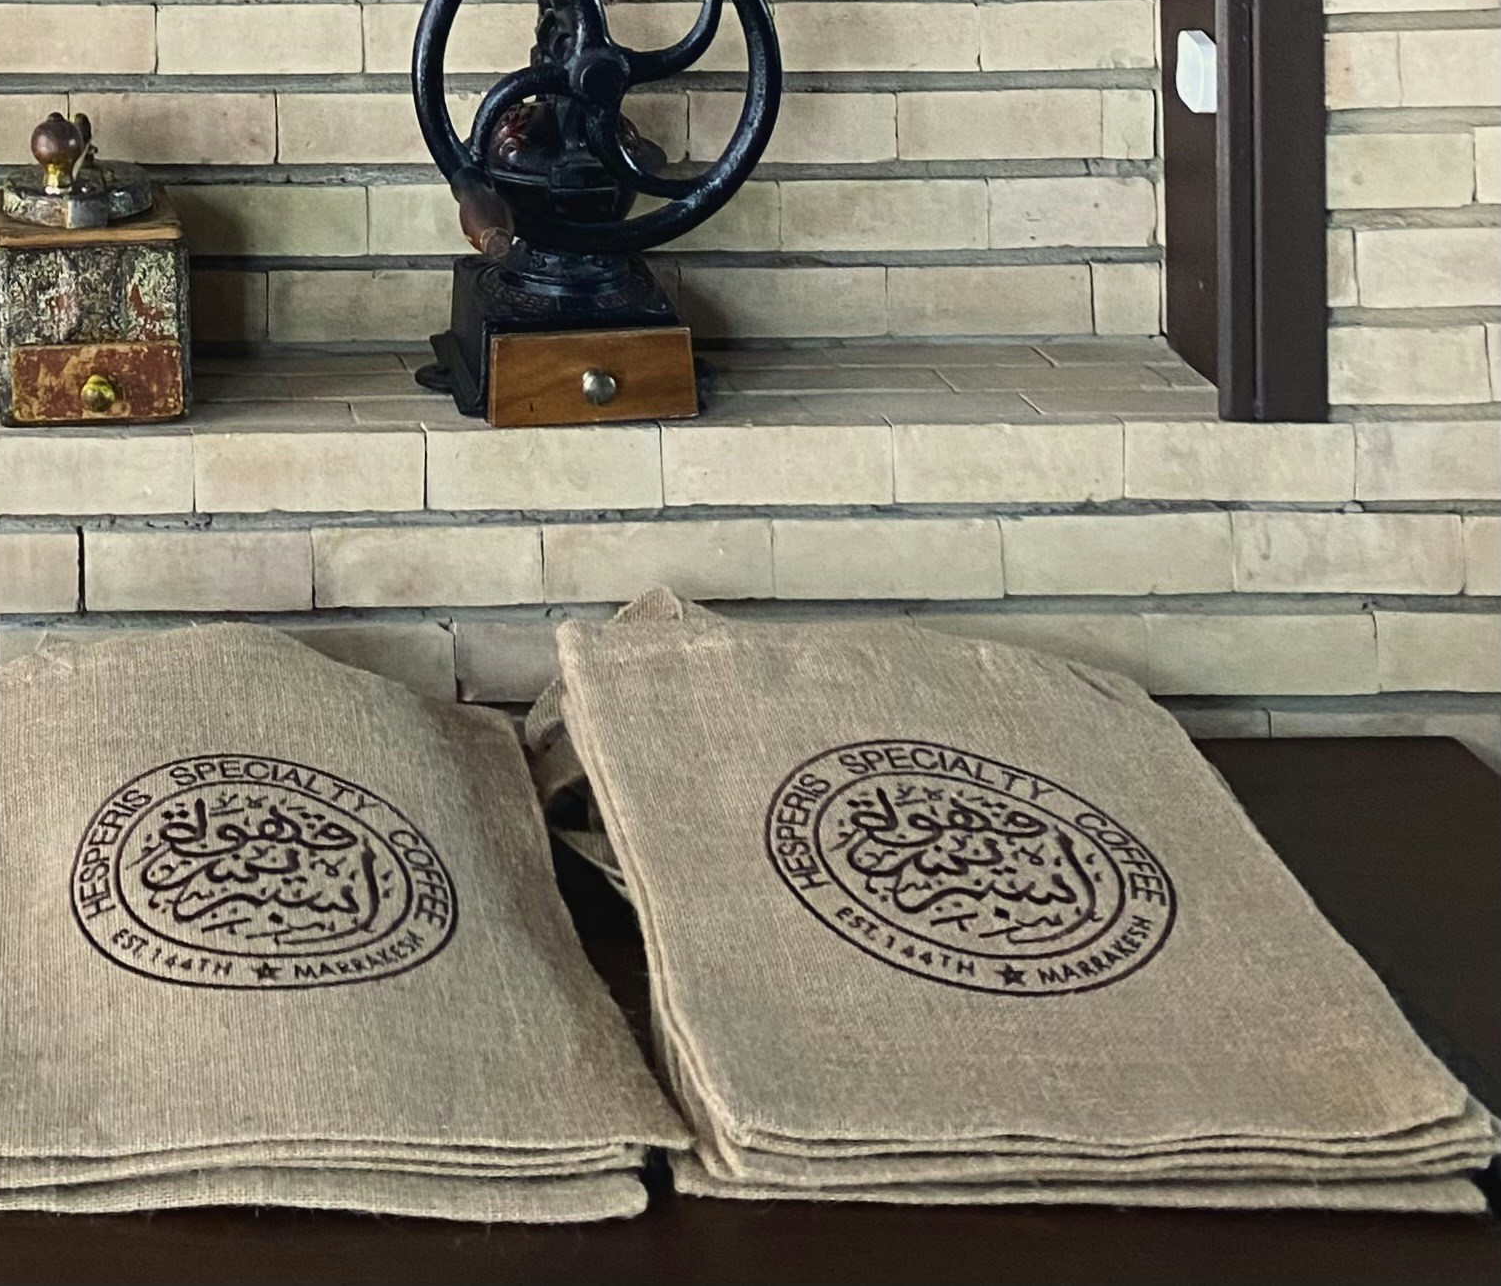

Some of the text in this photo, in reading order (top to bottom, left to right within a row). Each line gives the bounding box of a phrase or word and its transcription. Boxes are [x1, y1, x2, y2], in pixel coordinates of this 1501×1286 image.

[79, 759, 450, 928] HESPERIS SPECIALTY COFFEE
[778, 747, 1167, 908] HESPERIS SPECIALTY COFFEE
[294, 929, 426, 979] MARRAKESH
[1037, 914, 1154, 985] MARRAKESH
